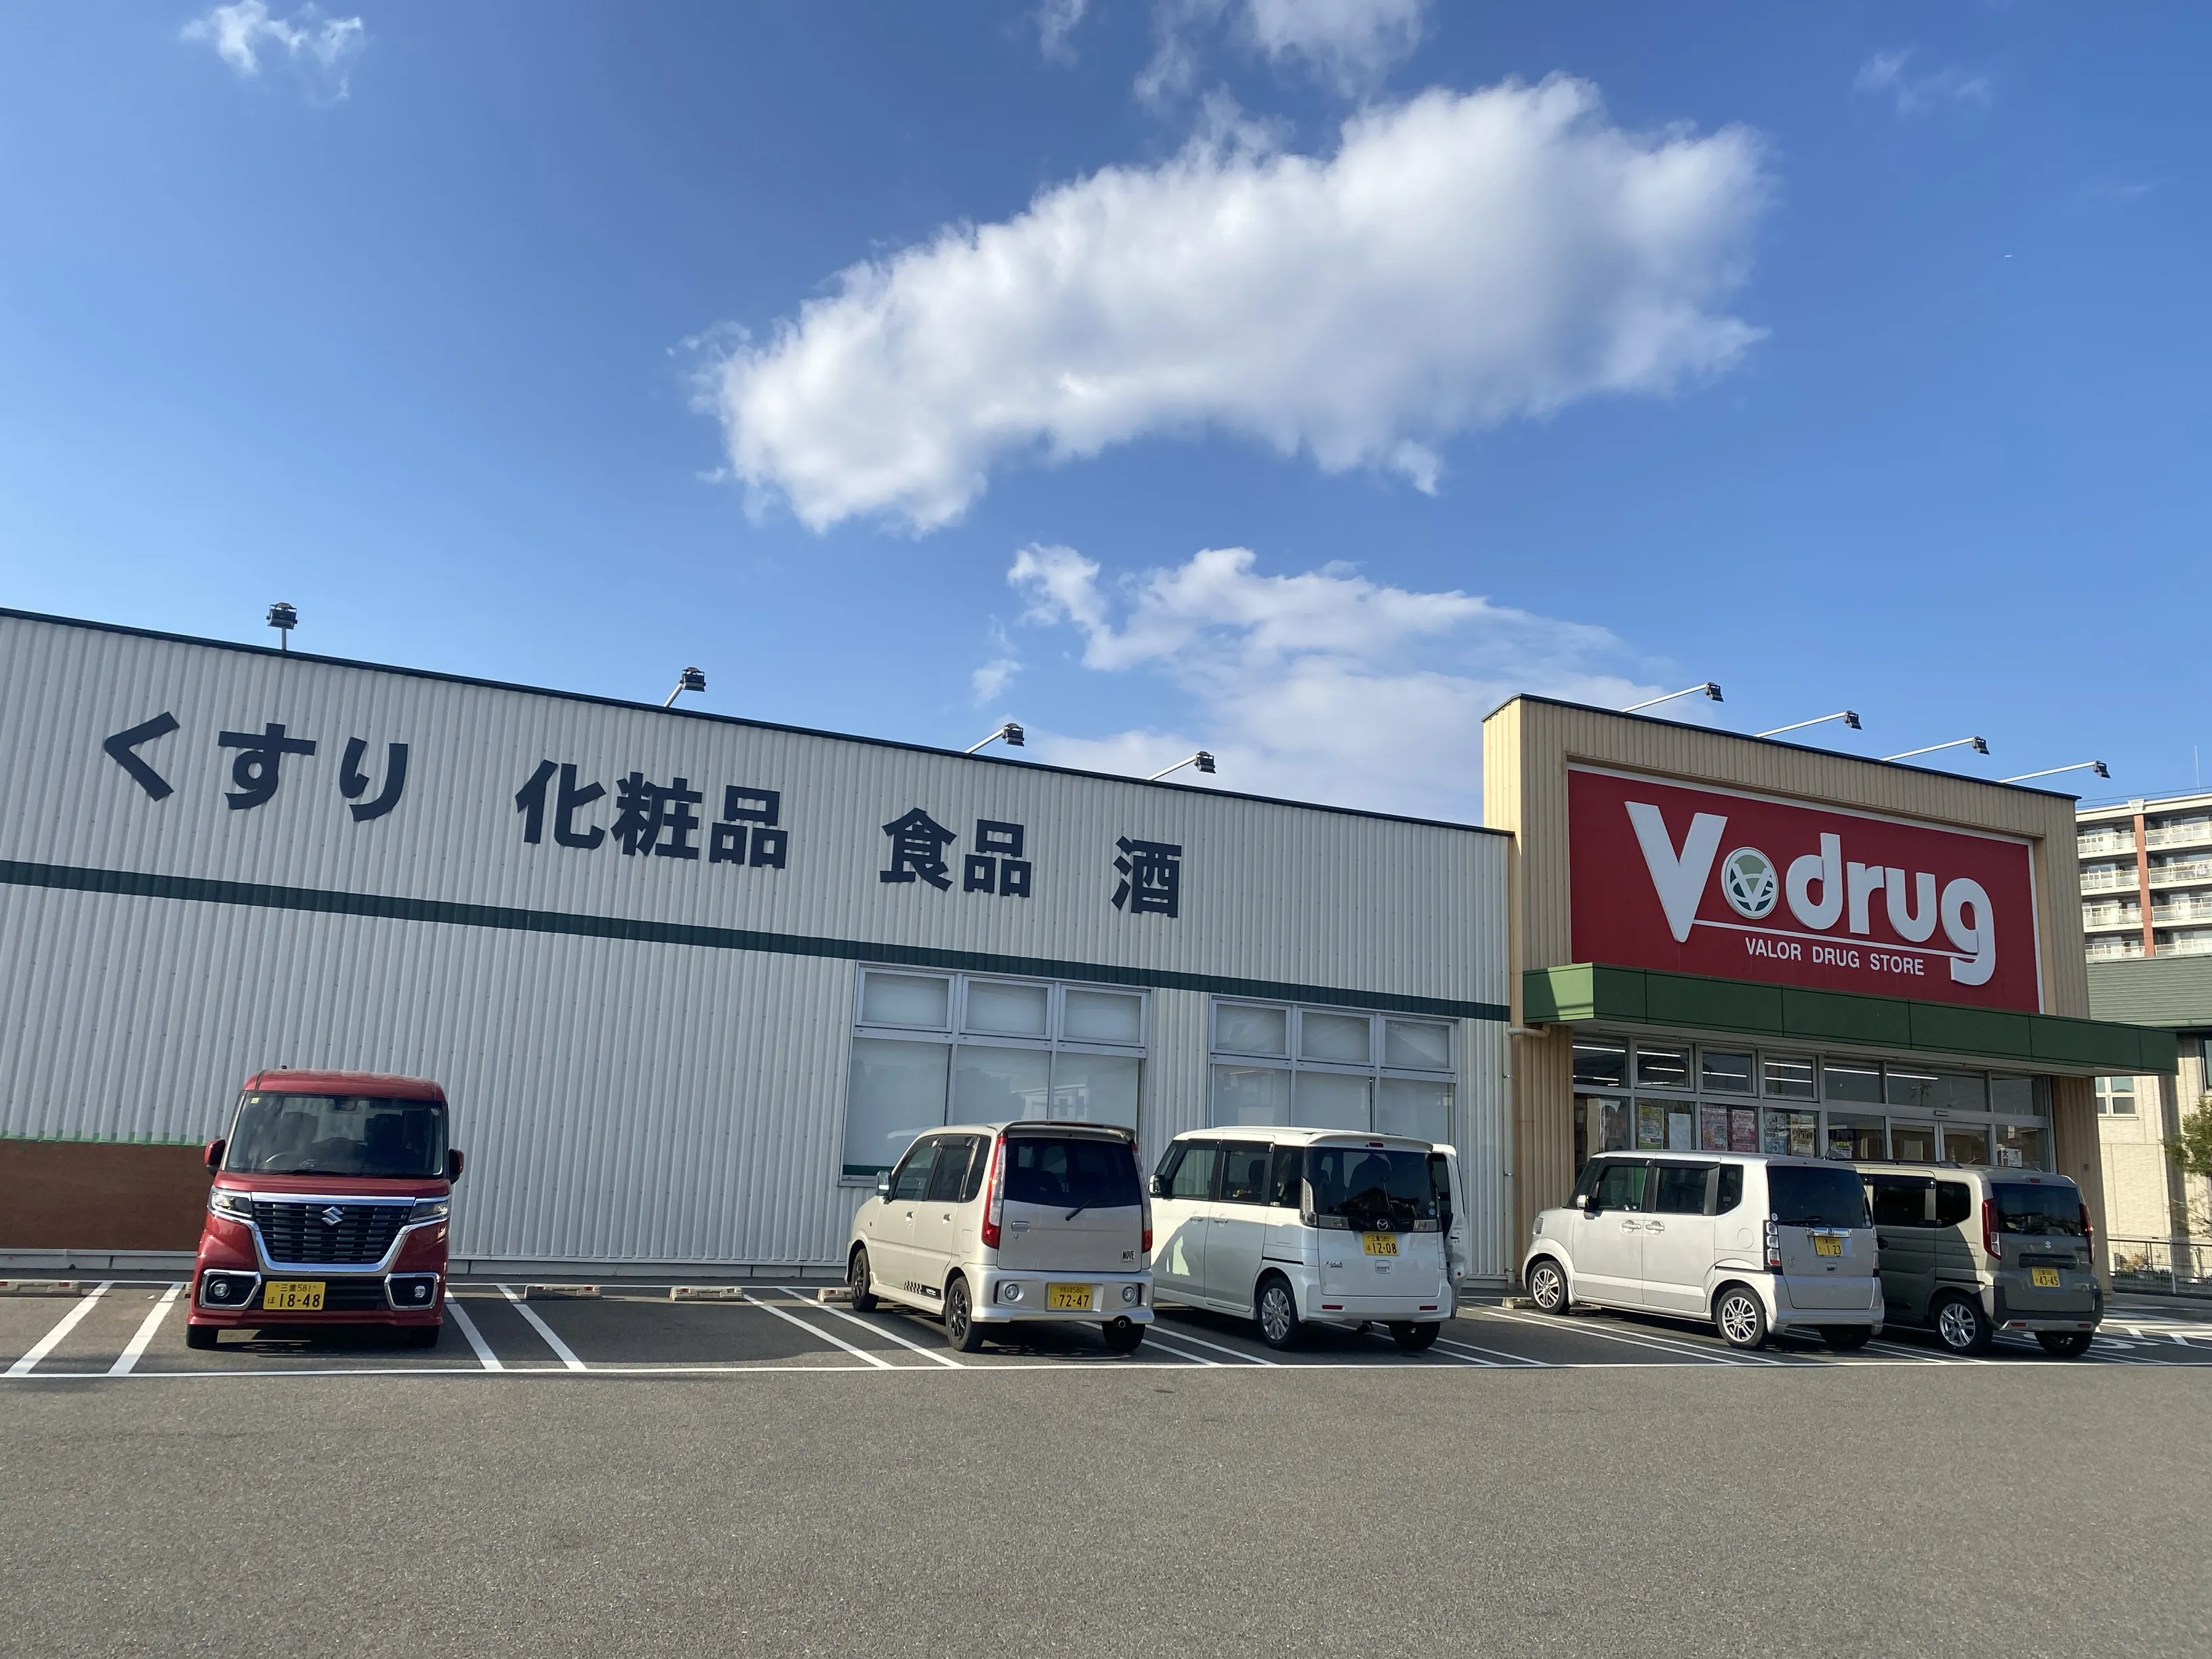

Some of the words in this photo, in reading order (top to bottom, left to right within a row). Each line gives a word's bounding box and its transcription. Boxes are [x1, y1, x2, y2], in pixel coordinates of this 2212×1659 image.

[104, 711, 408, 822] くすり
[515, 759, 788, 869] 化粧品
[880, 807, 1031, 898] 食品
[1111, 836, 1182, 918] 酒
[1745, 937, 1801, 961] VALOR
[1812, 946, 1860, 968] DRUG
[1870, 953, 1925, 975] STORE
[1372, 1242, 1397, 1254] 12-08
[1122, 1250, 1134, 1260] MOVE
[2040, 1275, 2059, 1286] 43-45
[279, 1293, 320, 1308] 18-48
[1059, 1294, 1090, 1307] 72-47
